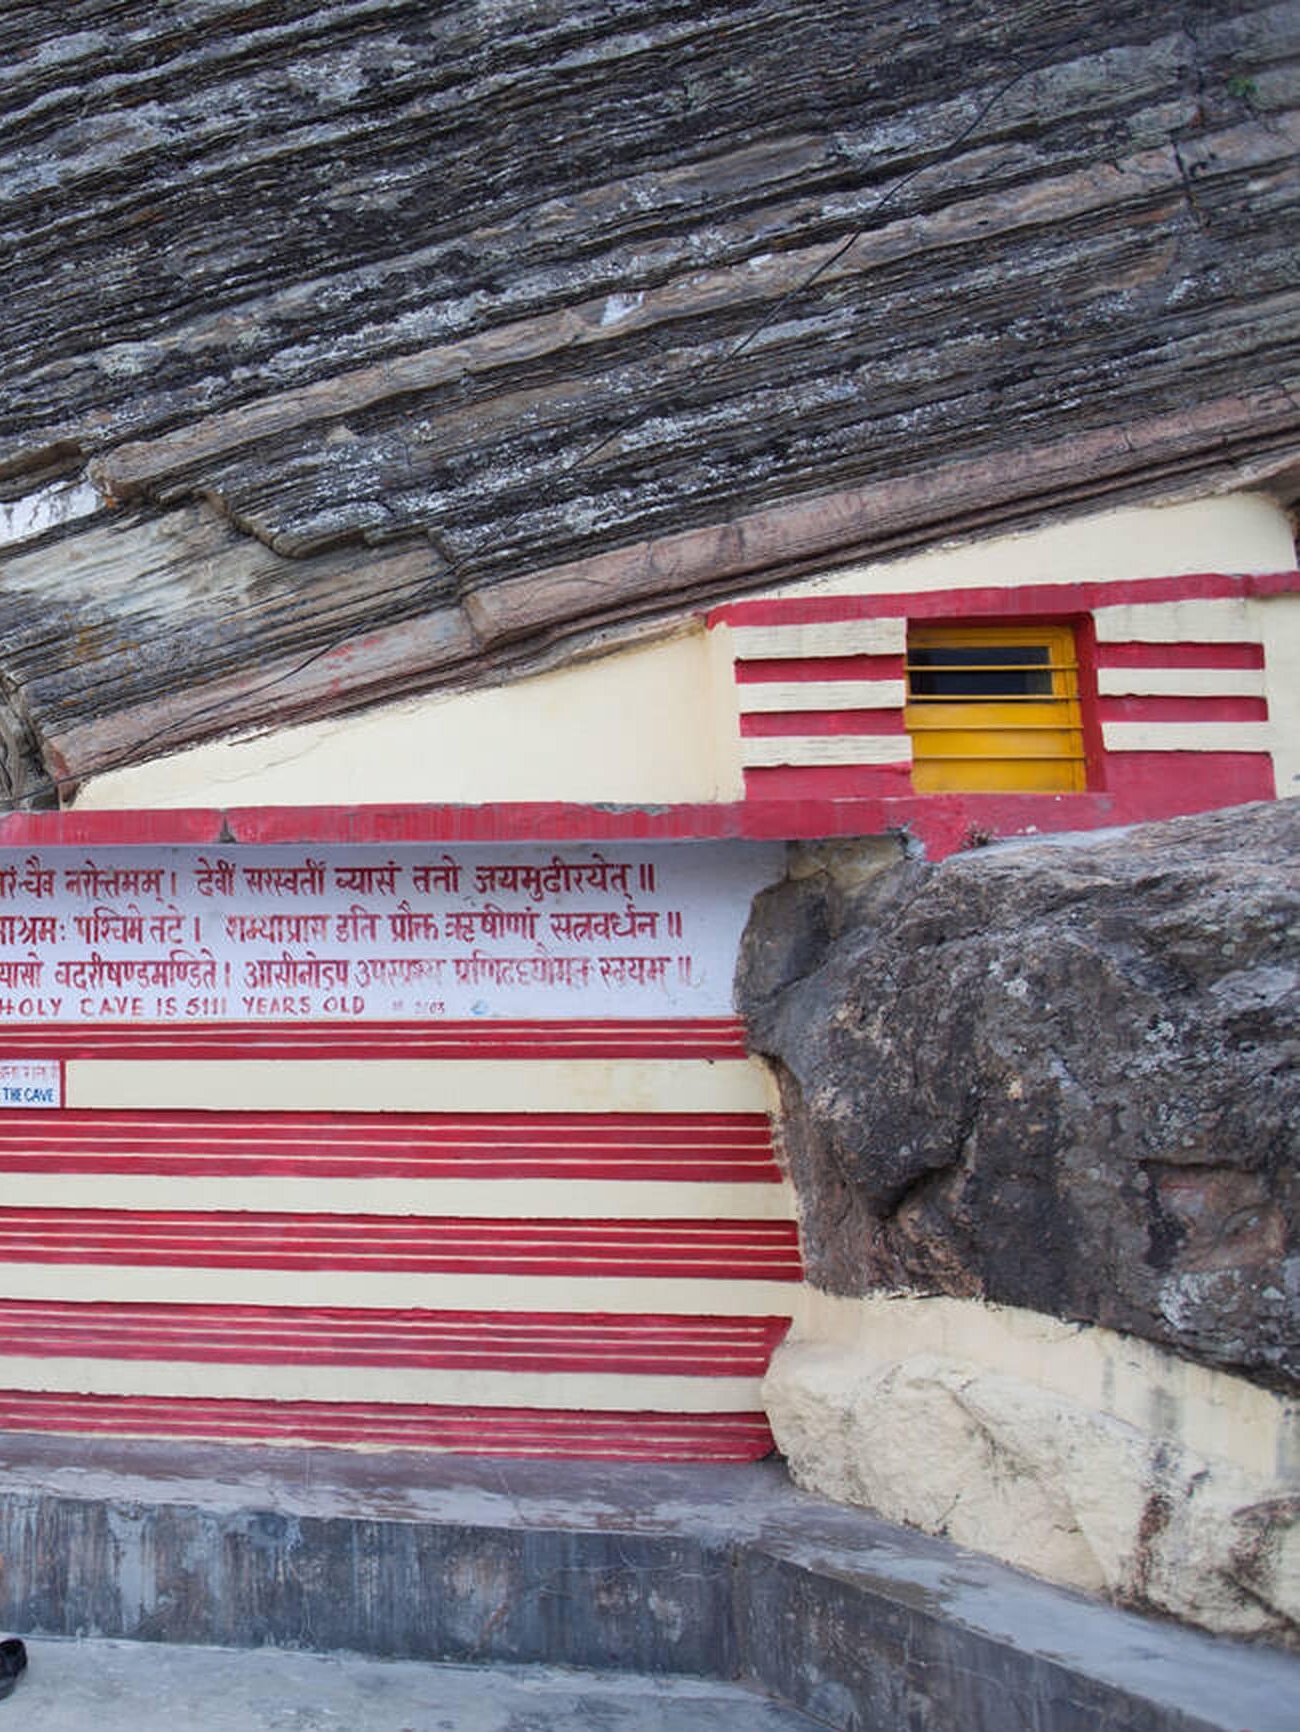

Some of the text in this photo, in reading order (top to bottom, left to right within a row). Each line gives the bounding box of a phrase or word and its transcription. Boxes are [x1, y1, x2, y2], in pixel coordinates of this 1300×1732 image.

[334, 860, 402, 896] व्यासं
[412, 855, 462, 893] ततो
[80, 996, 144, 1017] CAVE
[156, 997, 178, 1017] IS
[242, 996, 311, 1016] YEARS
[323, 996, 365, 1014] OLD
[2, 1087, 22, 1101] THE
[24, 1088, 54, 1102] CAVE
